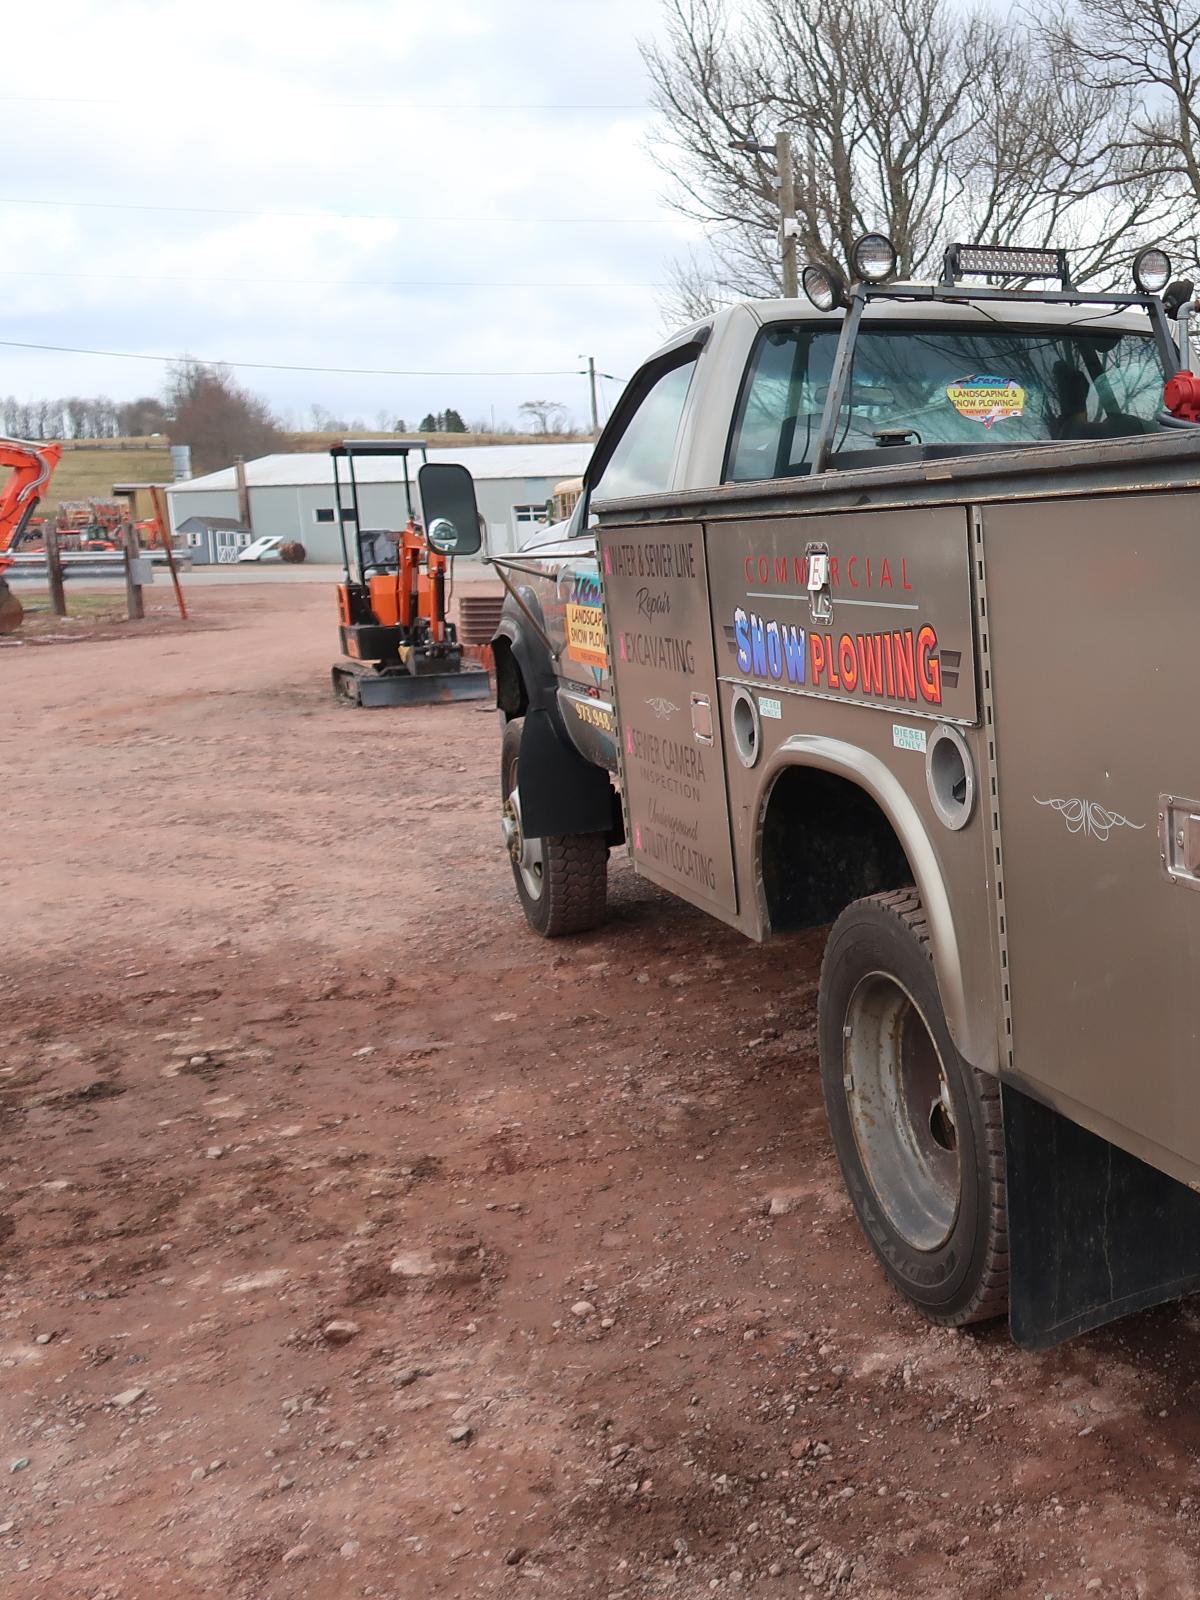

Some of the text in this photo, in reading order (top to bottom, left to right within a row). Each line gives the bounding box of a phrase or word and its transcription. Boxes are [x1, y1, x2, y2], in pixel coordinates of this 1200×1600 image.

[953, 390, 1017, 398] LANDSCAPING &
[607, 543, 696, 578] WATER & SEWER LINE
[743, 555, 913, 590] COMMERCIAL
[635, 587, 671, 624] Repair
[570, 627, 588, 645] SNOW
[624, 632, 695, 674] EXCAVATING
[733, 605, 943, 706] SNOW PLOWING
[760, 697, 781, 708] DIESEL
[762, 707, 778, 717] ONLY
[893, 726, 926, 741] DIESEL
[898, 738, 921, 750] ONLY
[632, 728, 706, 783] SEWER CAMERA
[639, 766, 701, 802] INSPECTION
[647, 798, 698, 842] Underground
[641, 826, 716, 891] UTILITY LOCATING
